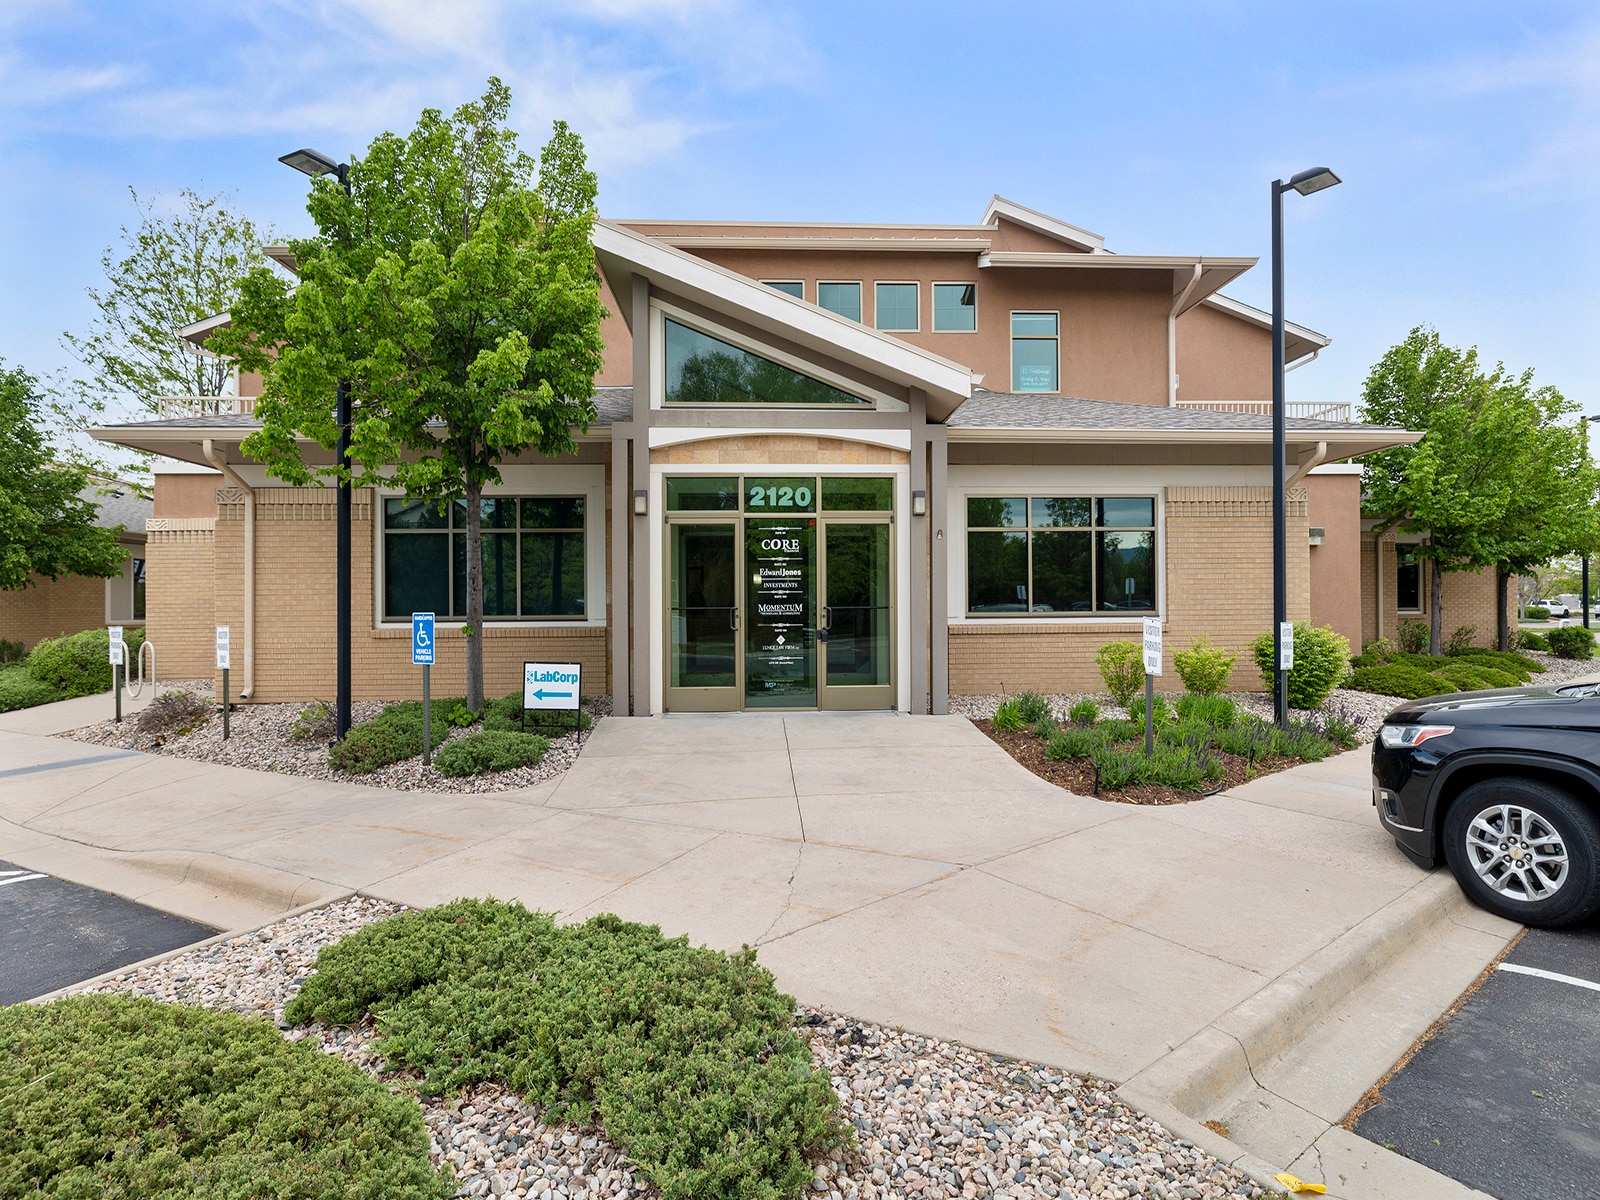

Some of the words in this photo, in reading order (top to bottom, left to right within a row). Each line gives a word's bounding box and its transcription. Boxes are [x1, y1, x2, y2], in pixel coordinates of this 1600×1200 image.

[749, 486, 812, 507] 2120
[761, 538, 800, 550] CORE
[1145, 624, 1161, 637] VISITOR
[1145, 639, 1161, 653] PARKING
[533, 670, 579, 685] LabCorp
